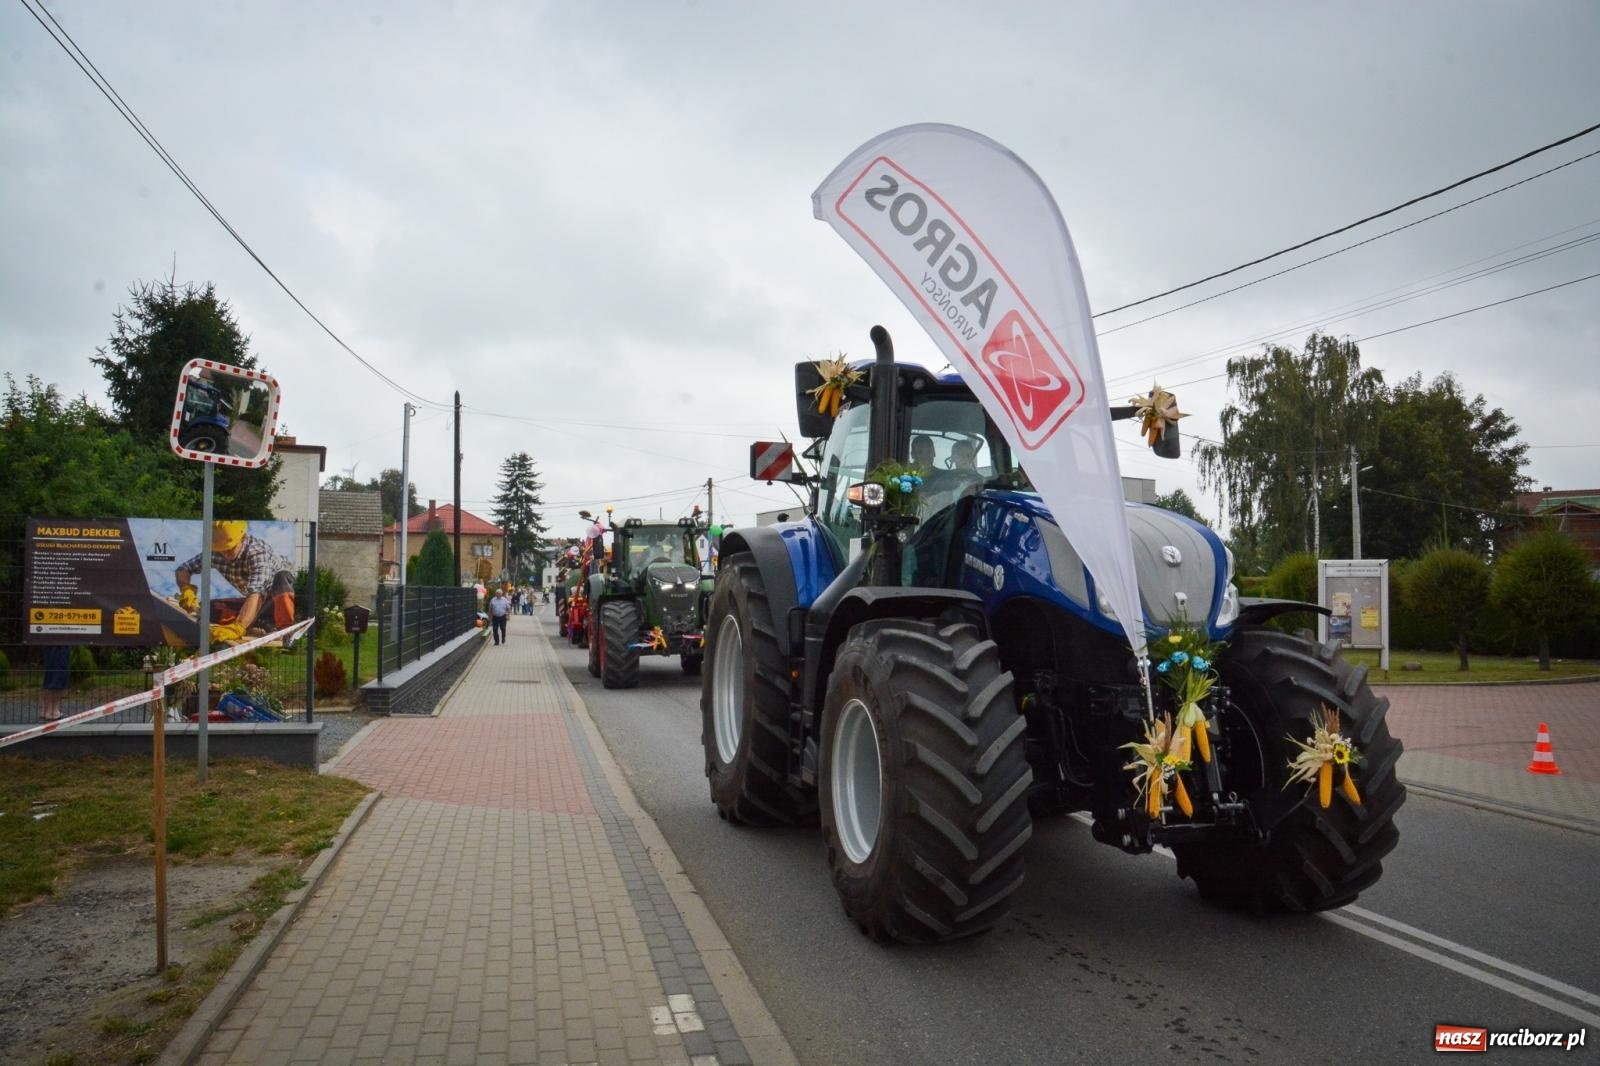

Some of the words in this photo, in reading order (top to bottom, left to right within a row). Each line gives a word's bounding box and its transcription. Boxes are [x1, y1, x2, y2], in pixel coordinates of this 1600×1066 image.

[37, 527, 80, 536] MAXBUD
[82, 528, 120, 537] DEKKER
[154, 542, 167, 554] M
